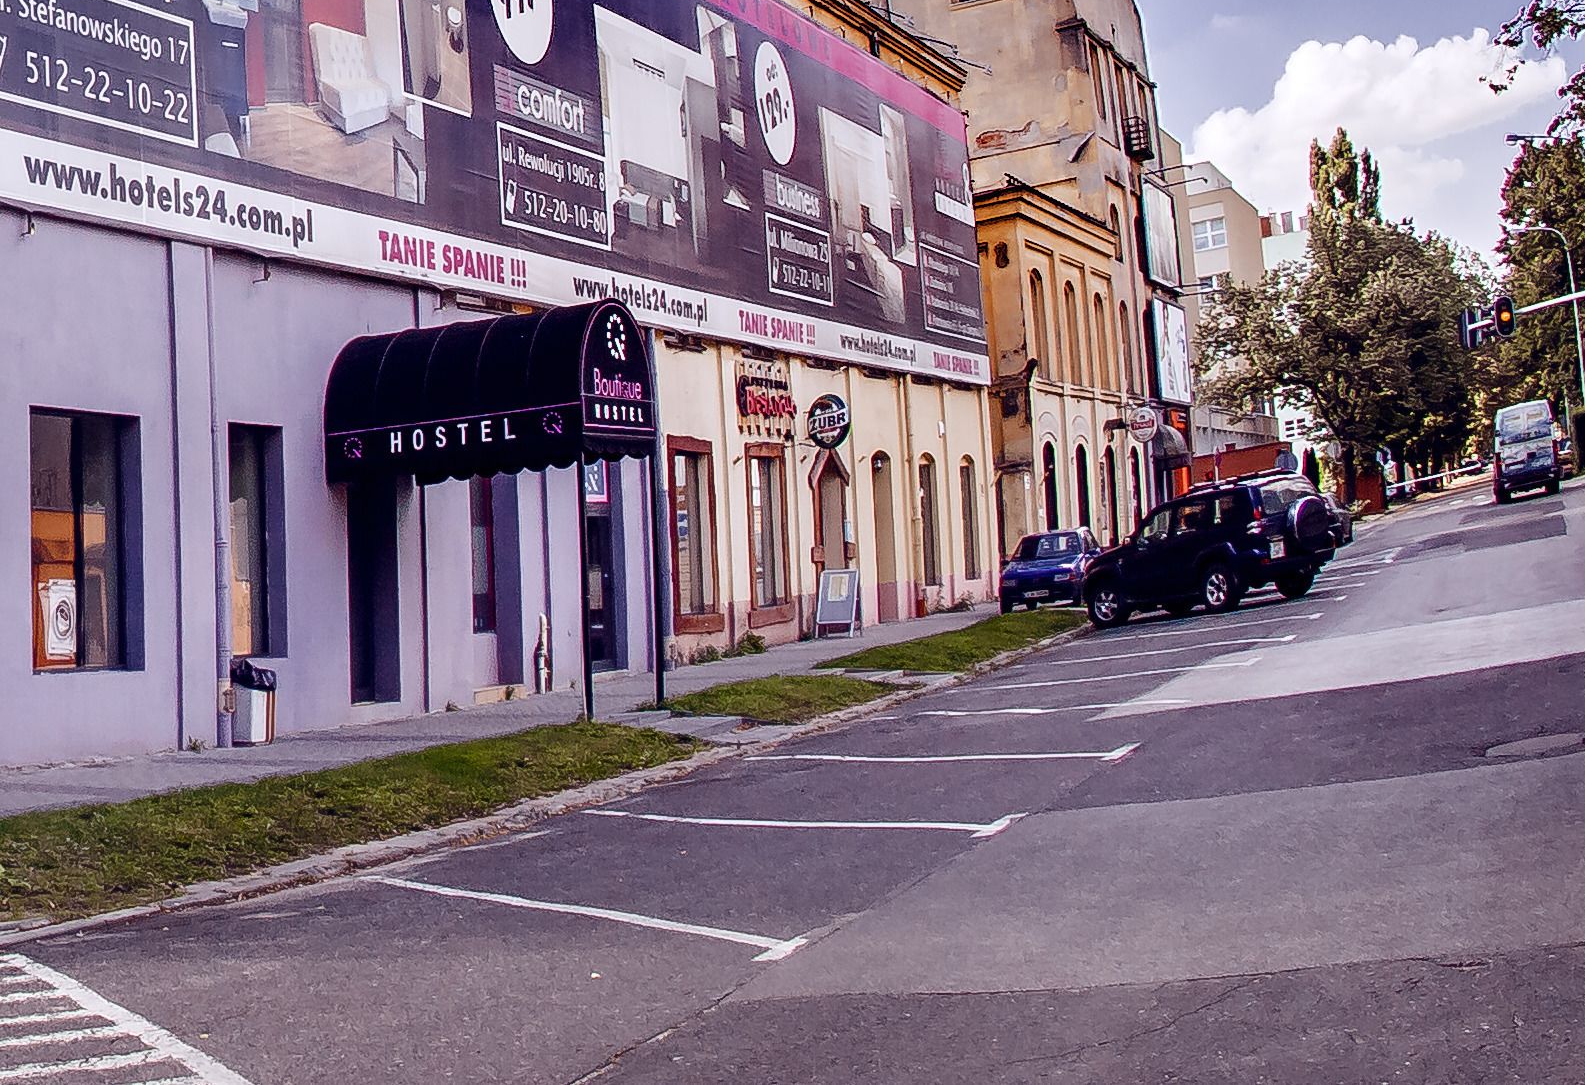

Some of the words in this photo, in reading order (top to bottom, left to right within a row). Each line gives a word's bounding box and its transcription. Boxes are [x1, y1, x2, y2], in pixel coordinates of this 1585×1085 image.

[168, 36, 189, 65] 17
[25, 50, 190, 125] 512-22-10-22
[517, 84, 586, 135] comfort
[518, 146, 565, 184] Rewolucji
[566, 160, 597, 189] 1905r.
[598, 170, 606, 193] 8
[22, 152, 314, 244] www.hotels24.com.pl
[523, 190, 607, 235] 512-20-10-80
[378, 230, 436, 271] TANIE
[442, 244, 506, 285] SPANIE
[510, 258, 528, 289] !!!
[573, 273, 709, 324] www.hotels24.com.pl
[739, 309, 768, 338] TANIE
[771, 316, 804, 344] SPANIE
[390, 417, 516, 453] HOSTEL
[594, 403, 644, 423] HOSTEL
